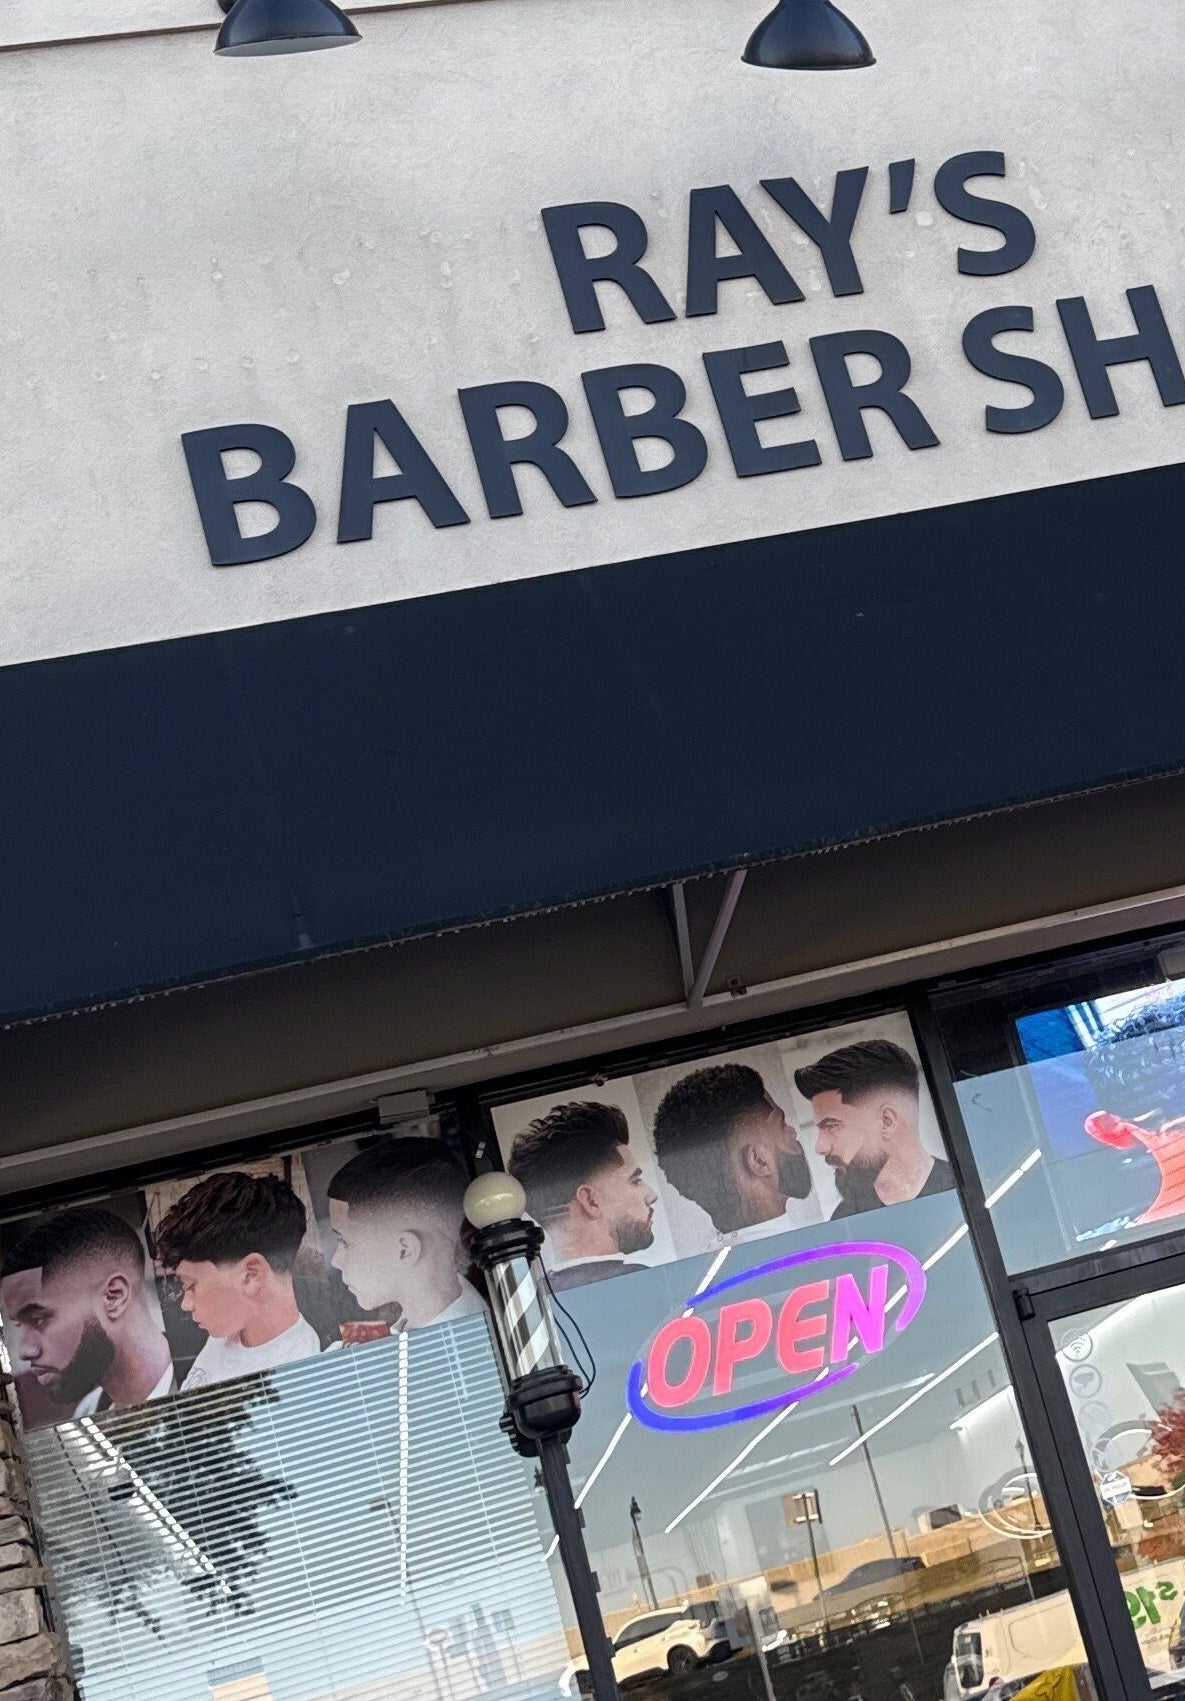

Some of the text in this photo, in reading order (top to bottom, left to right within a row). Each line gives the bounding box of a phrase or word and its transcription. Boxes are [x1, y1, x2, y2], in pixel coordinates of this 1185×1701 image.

[540, 150, 1037, 335] RAY'S
[181, 328, 942, 567] BARBER
[647, 1264, 889, 1408] OPEN
